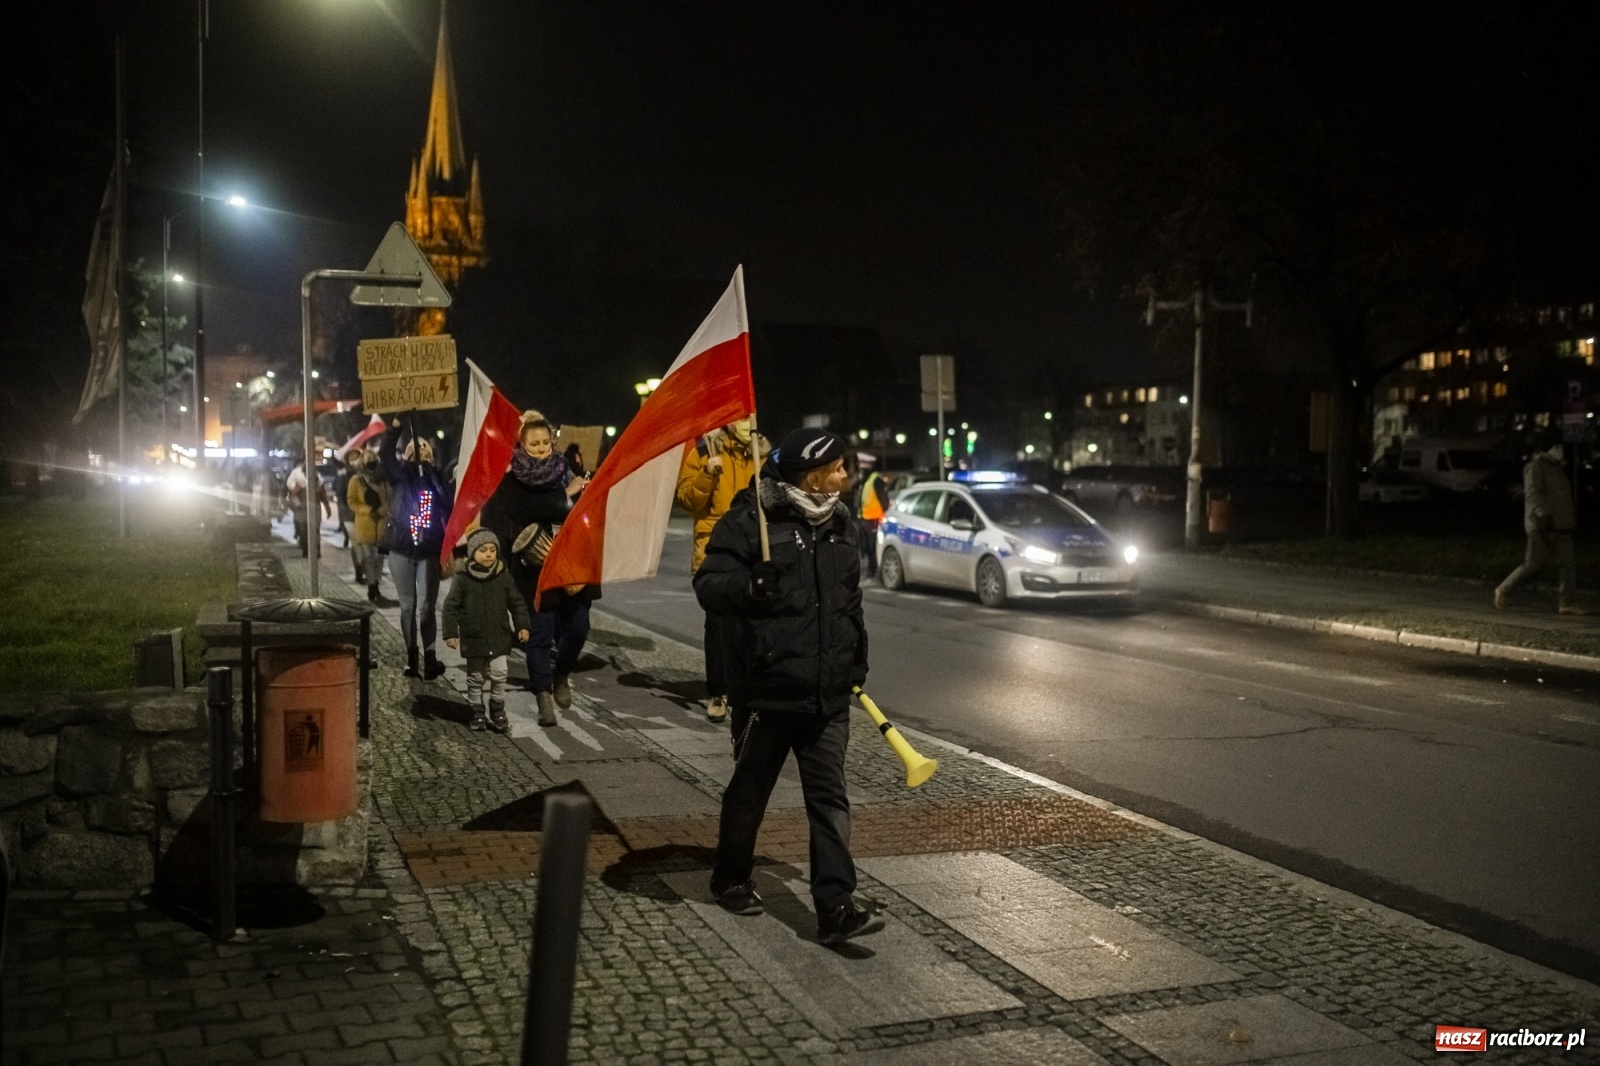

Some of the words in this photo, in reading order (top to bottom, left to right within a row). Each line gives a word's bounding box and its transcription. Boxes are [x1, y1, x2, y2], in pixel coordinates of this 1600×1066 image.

[365, 343, 407, 360] STRACH
[411, 355, 445, 372] LEPSZY
[399, 376, 415, 388] OD
[365, 387, 435, 410] WIBRATORA
